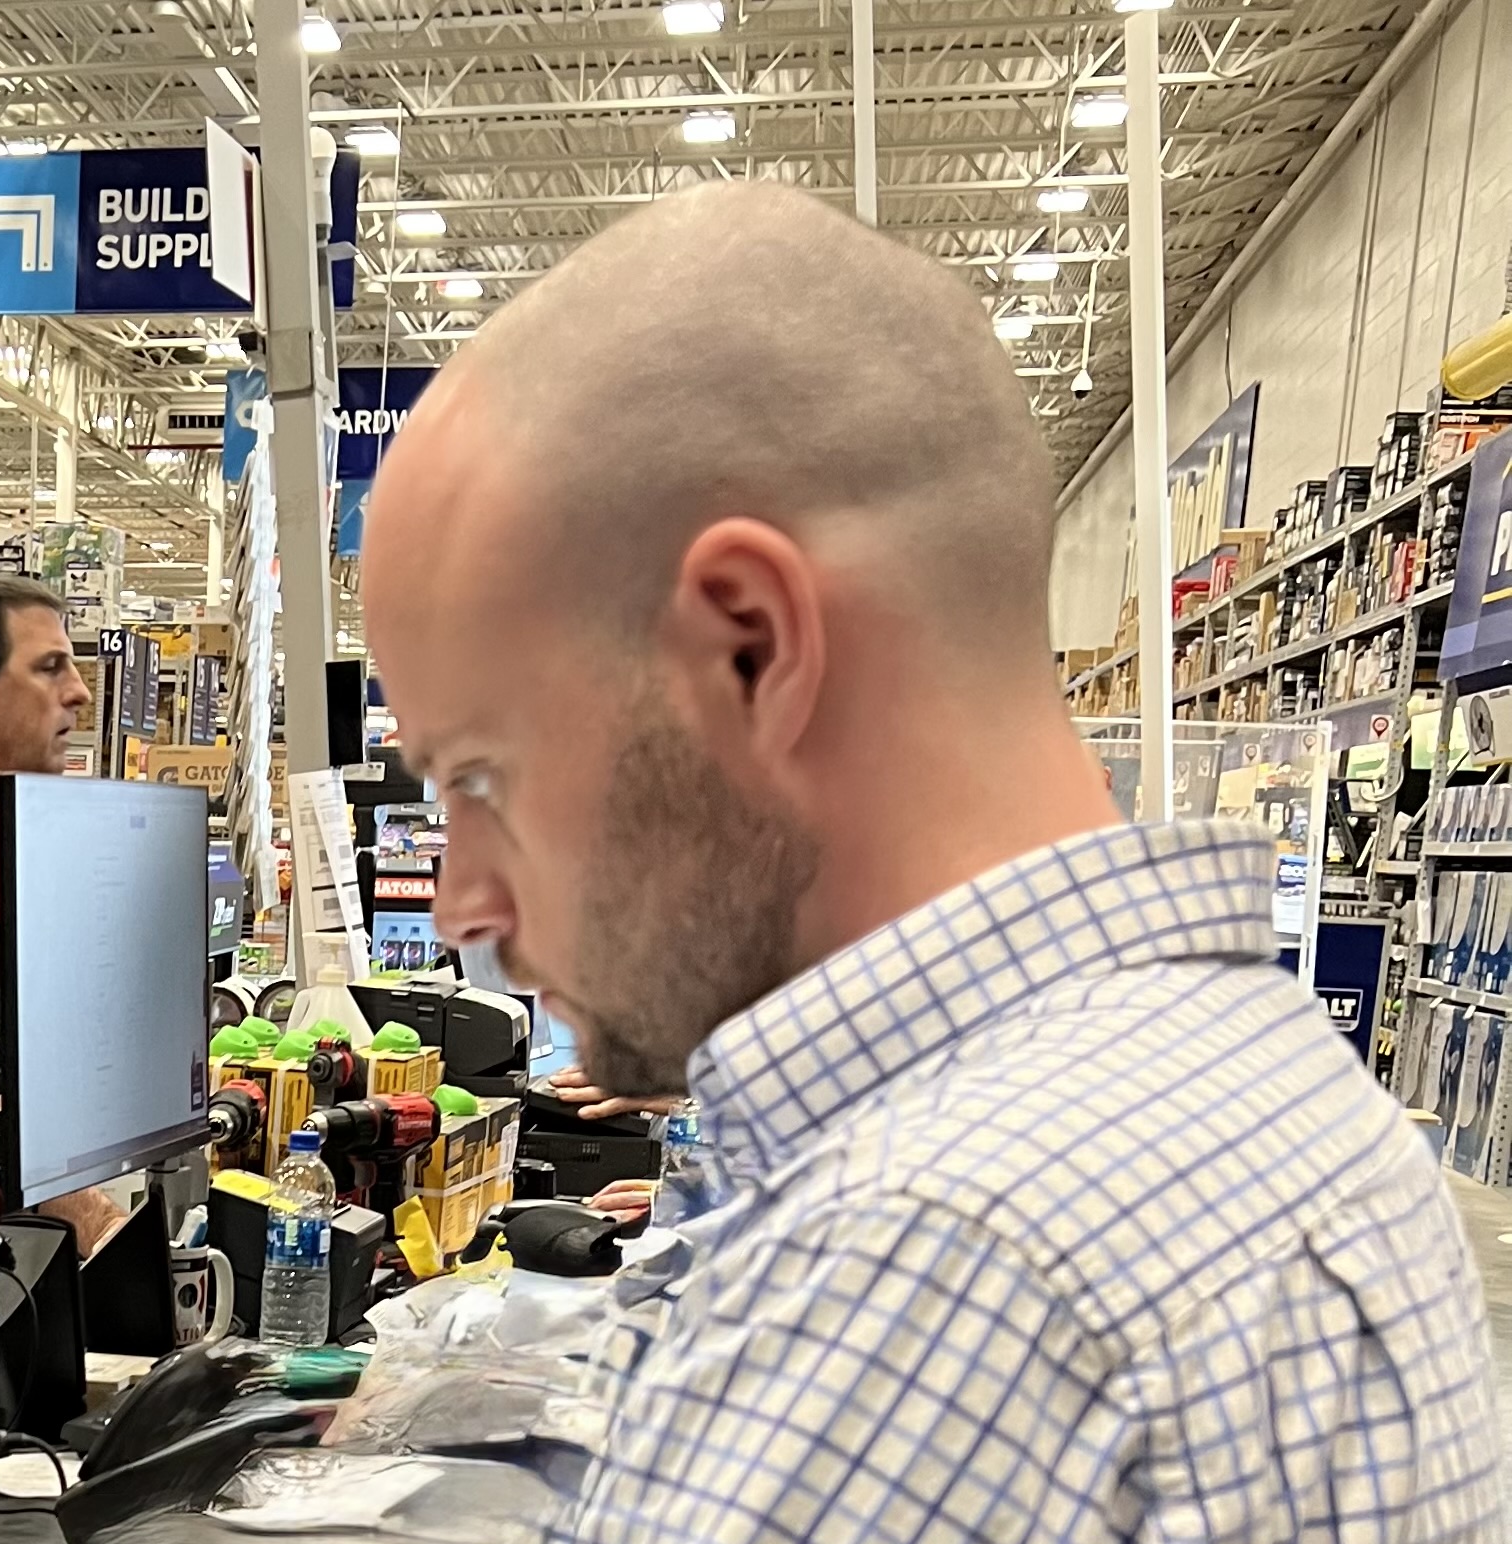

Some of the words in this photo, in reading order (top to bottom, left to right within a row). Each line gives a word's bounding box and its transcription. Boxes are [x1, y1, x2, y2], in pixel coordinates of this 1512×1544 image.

[99, 187, 210, 223] BUILD
[96, 233, 212, 270] SUPPL
[339, 409, 409, 434] ARDW
[101, 631, 123, 652] 16
